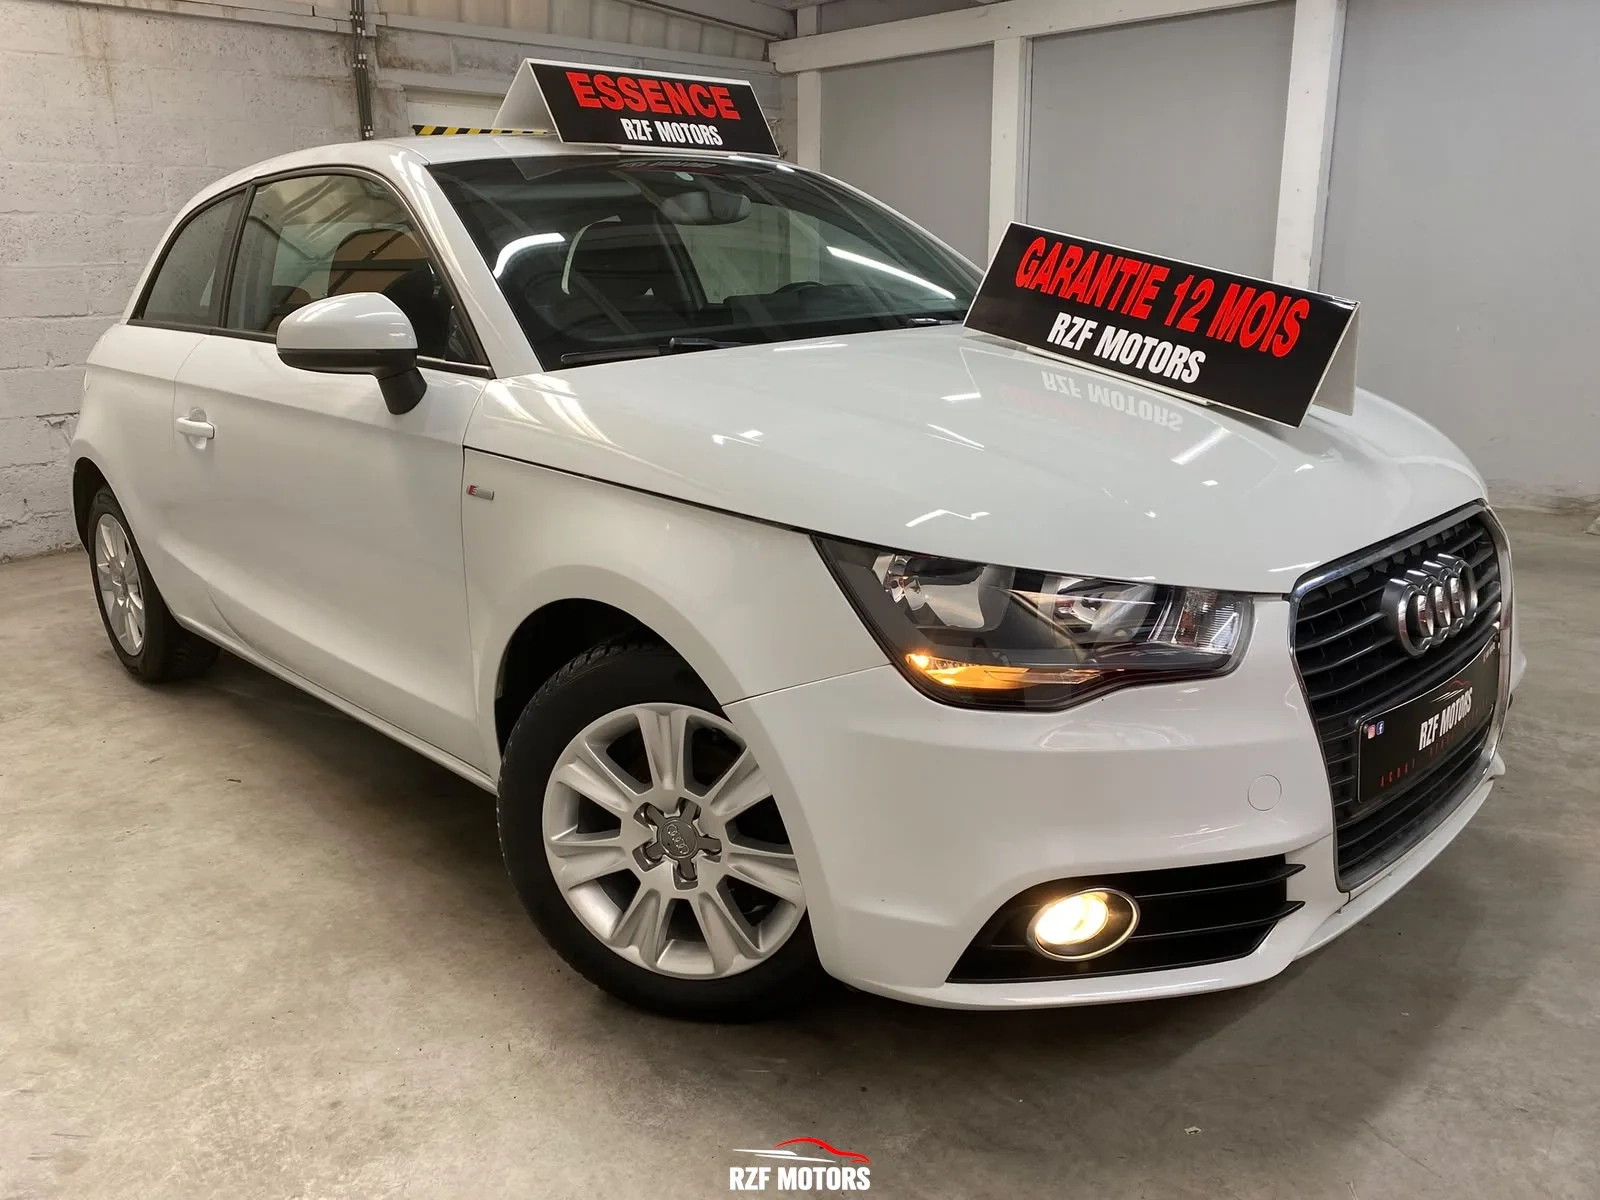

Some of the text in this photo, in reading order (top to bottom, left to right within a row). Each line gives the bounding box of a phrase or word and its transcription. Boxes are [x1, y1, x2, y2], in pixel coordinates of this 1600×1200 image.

[565, 71, 741, 120] ESSENCE
[620, 118, 724, 146] RZF MOTORS
[1014, 236, 1310, 358] GARANTIE 12 MOIS
[1046, 311, 1206, 384] RZF MOTORS
[1418, 713, 1440, 751] RZF
[1439, 687, 1473, 737] MOTORS
